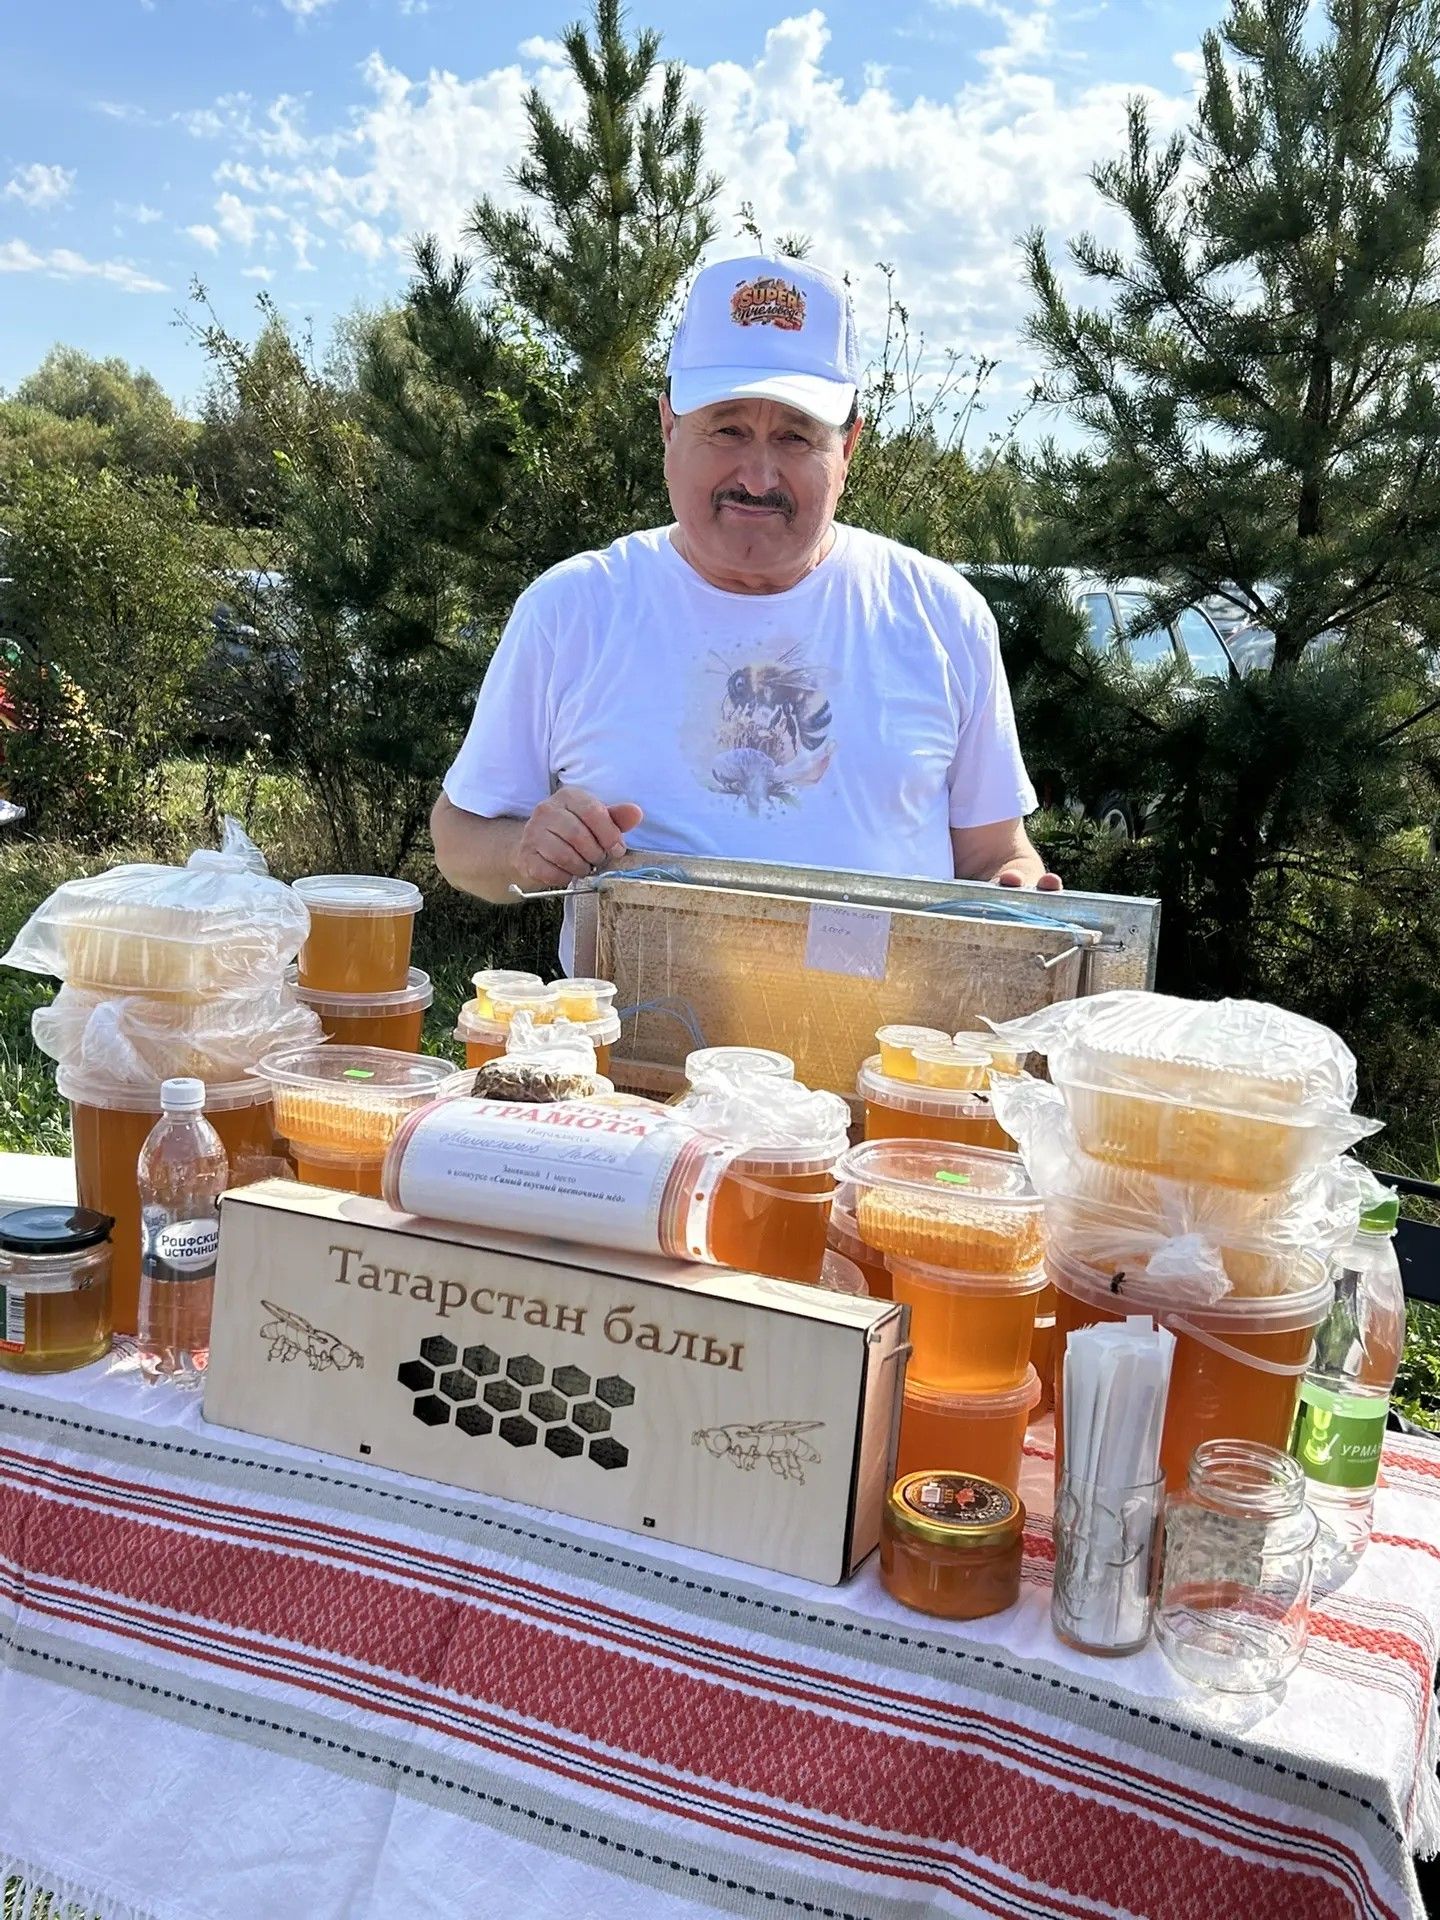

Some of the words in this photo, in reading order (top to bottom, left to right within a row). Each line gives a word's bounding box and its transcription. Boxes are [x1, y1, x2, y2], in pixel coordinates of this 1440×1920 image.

[740, 288, 799, 308] SUPER
[472, 1104, 647, 1136] ГРАМОТА
[161, 1231, 219, 1247] Раифски
[329, 1245, 588, 1336] Татарстан
[602, 1304, 746, 1373] балы
[1341, 1443, 1380, 1457] УРМА
